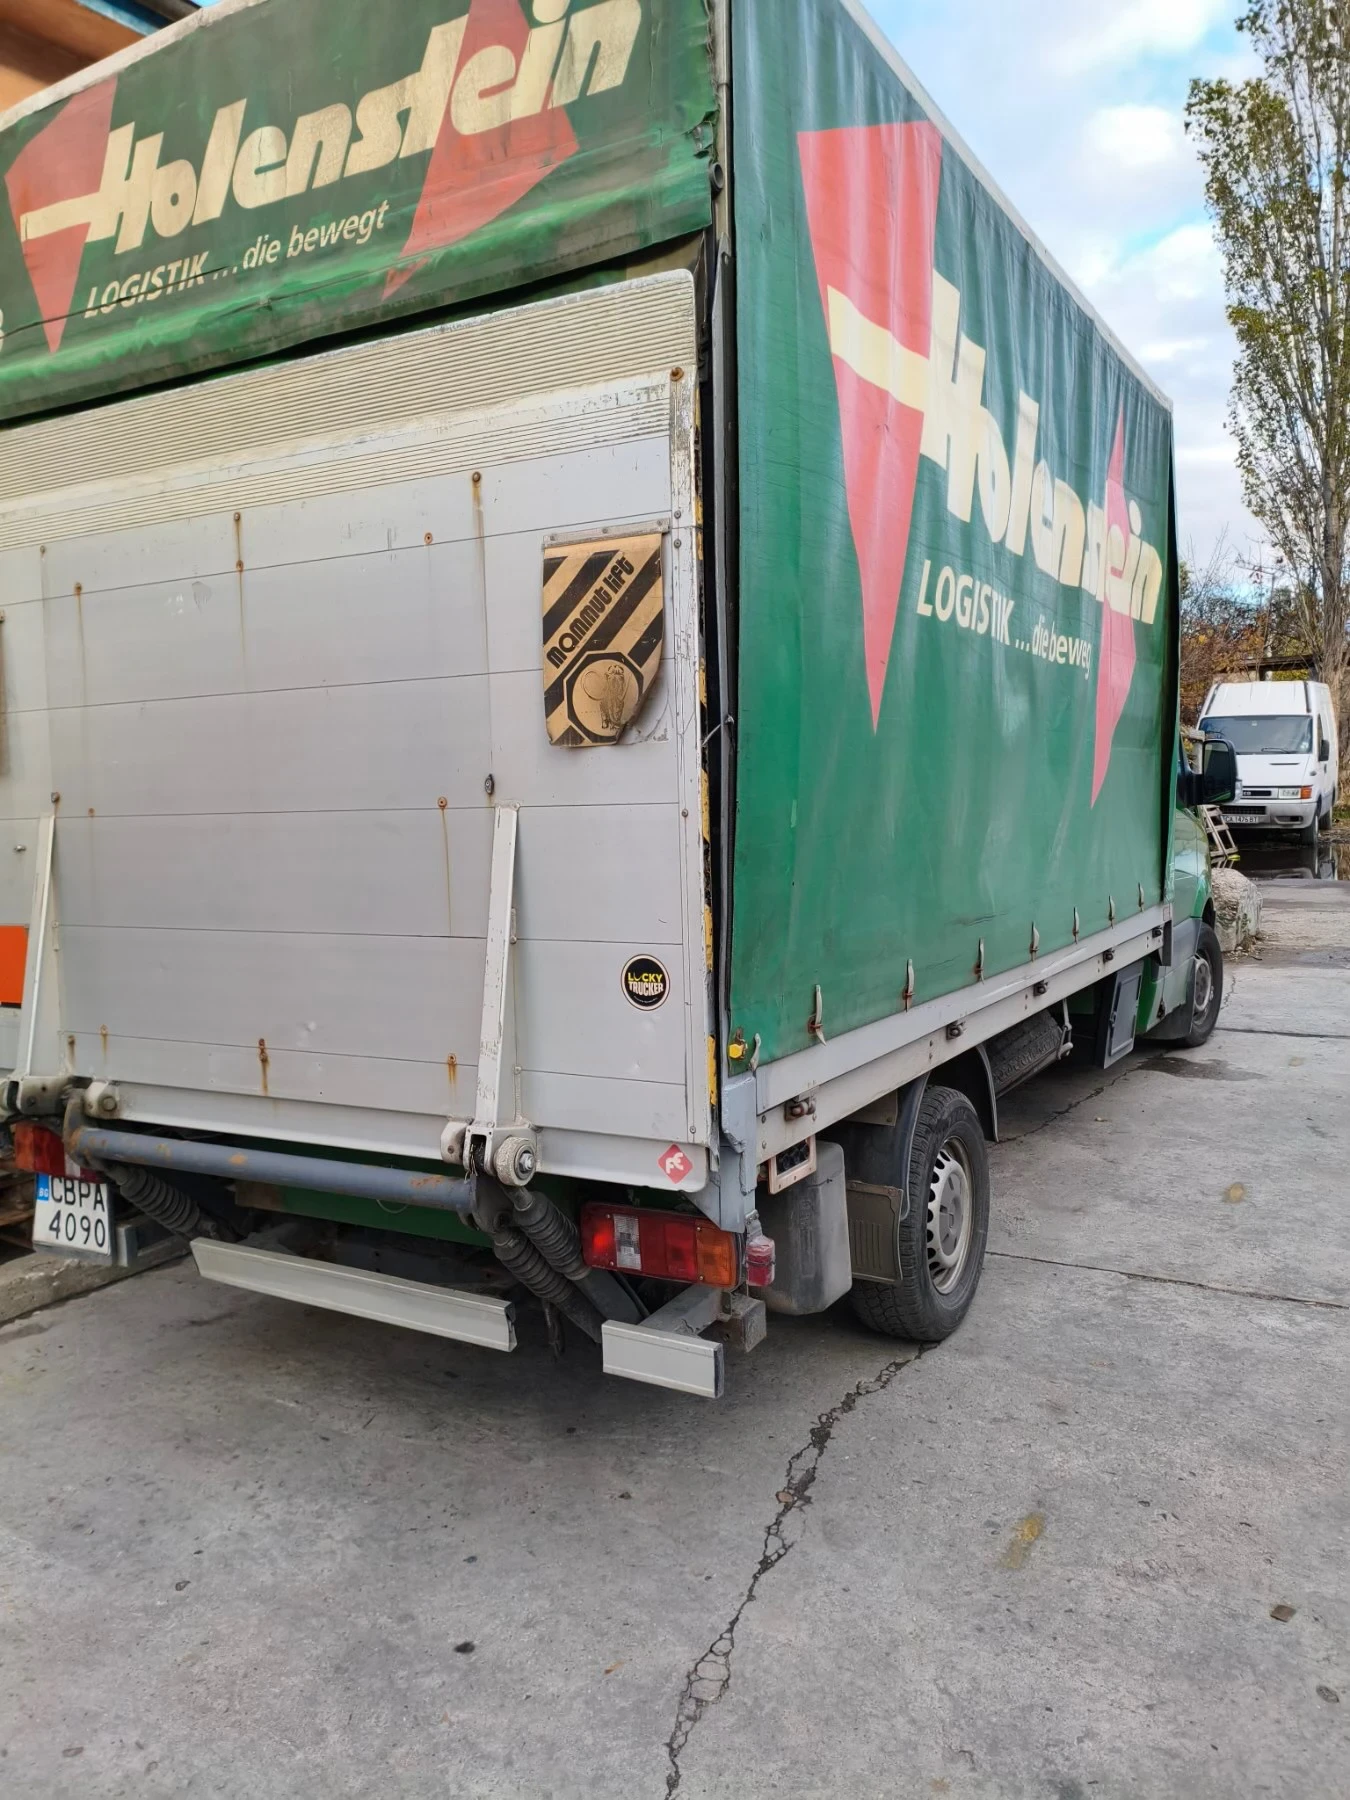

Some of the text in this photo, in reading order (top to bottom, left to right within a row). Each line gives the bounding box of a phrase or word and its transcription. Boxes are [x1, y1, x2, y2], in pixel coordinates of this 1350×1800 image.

[20, 0, 641, 255] Holenstein
[84, 251, 209, 318] LOGISTIK
[286, 199, 389, 258] bewegt
[917, 559, 1014, 646] LOGISTIK
[628, 972, 663, 983] LUCKY
[628, 981, 664, 996] TRUCKER
[50, 1176, 105, 1212] CBPA
[48, 1210, 106, 1248] 4090
